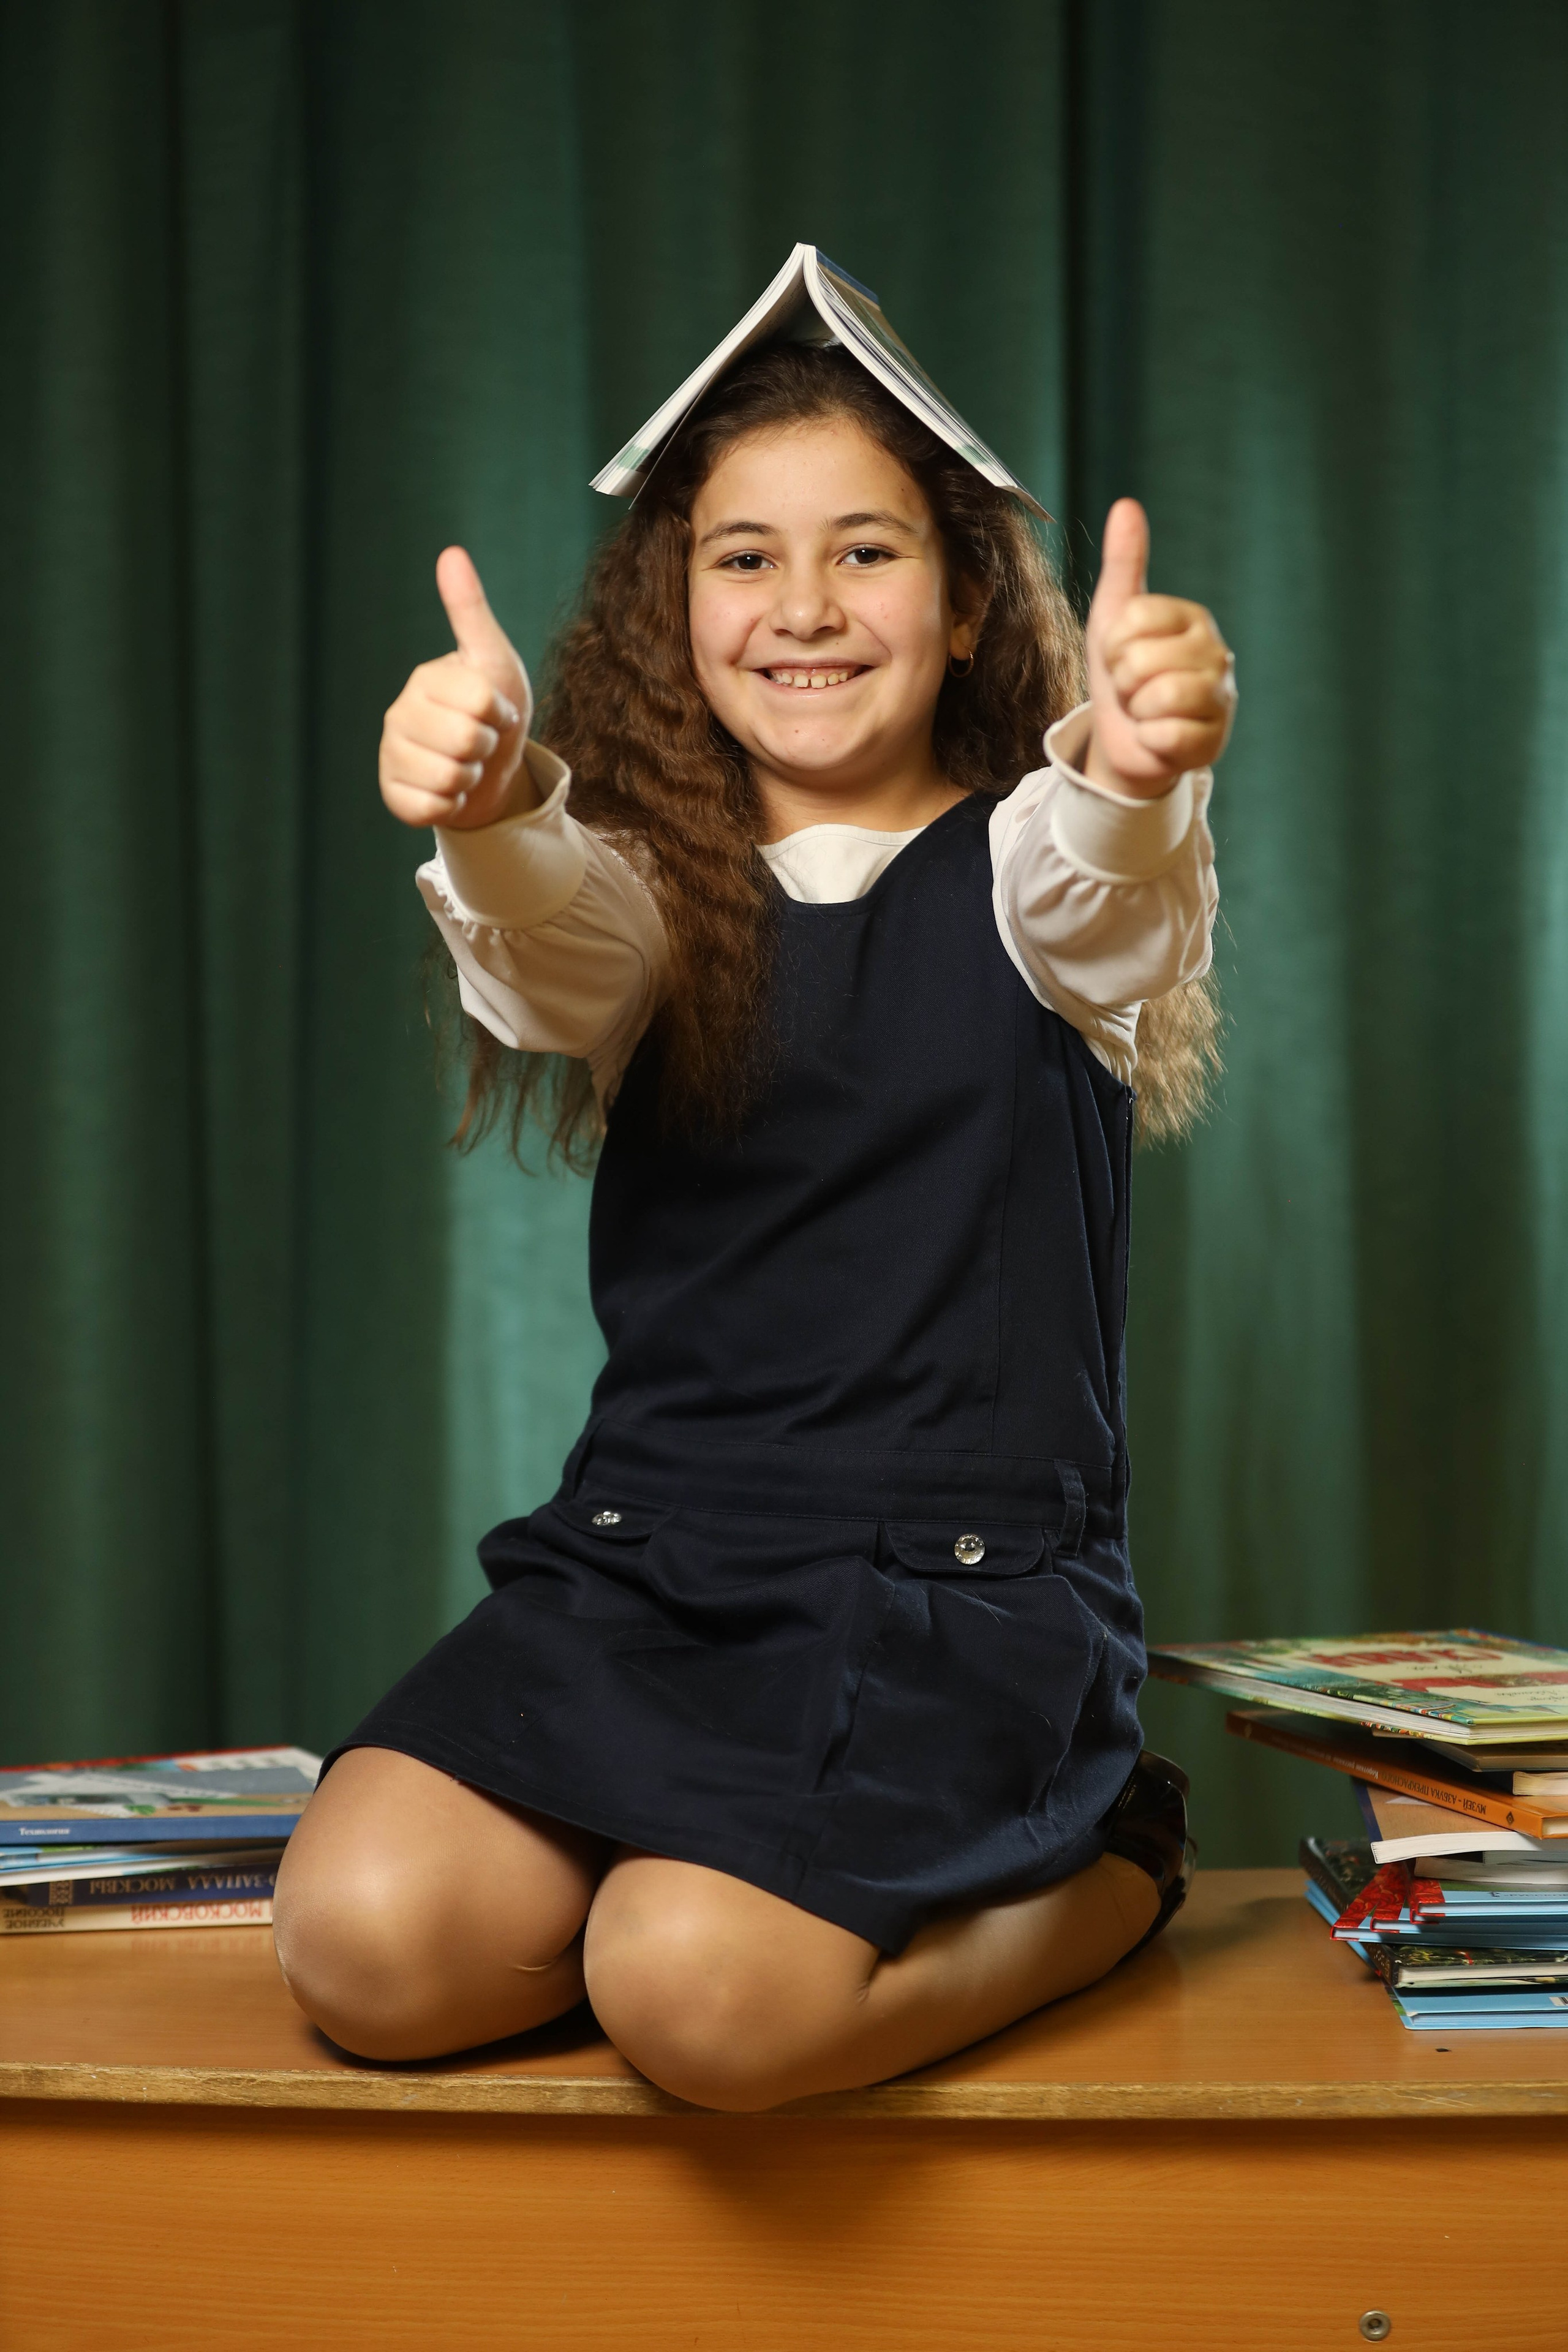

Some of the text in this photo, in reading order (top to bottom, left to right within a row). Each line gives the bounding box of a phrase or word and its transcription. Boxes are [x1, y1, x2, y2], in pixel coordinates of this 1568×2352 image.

[1431, 1787, 1457, 1804] АЗБУКА
[1463, 1798, 1487, 1815] МУЗЕЙ
[89, 1876, 176, 1895] МОСКВЫ
[4, 1907, 65, 1918] ПОСОБИЕ
[130, 1901, 262, 1924] МОСКОВСКИЙ
[5, 1918, 64, 1929] УЧЕБНОЕ
